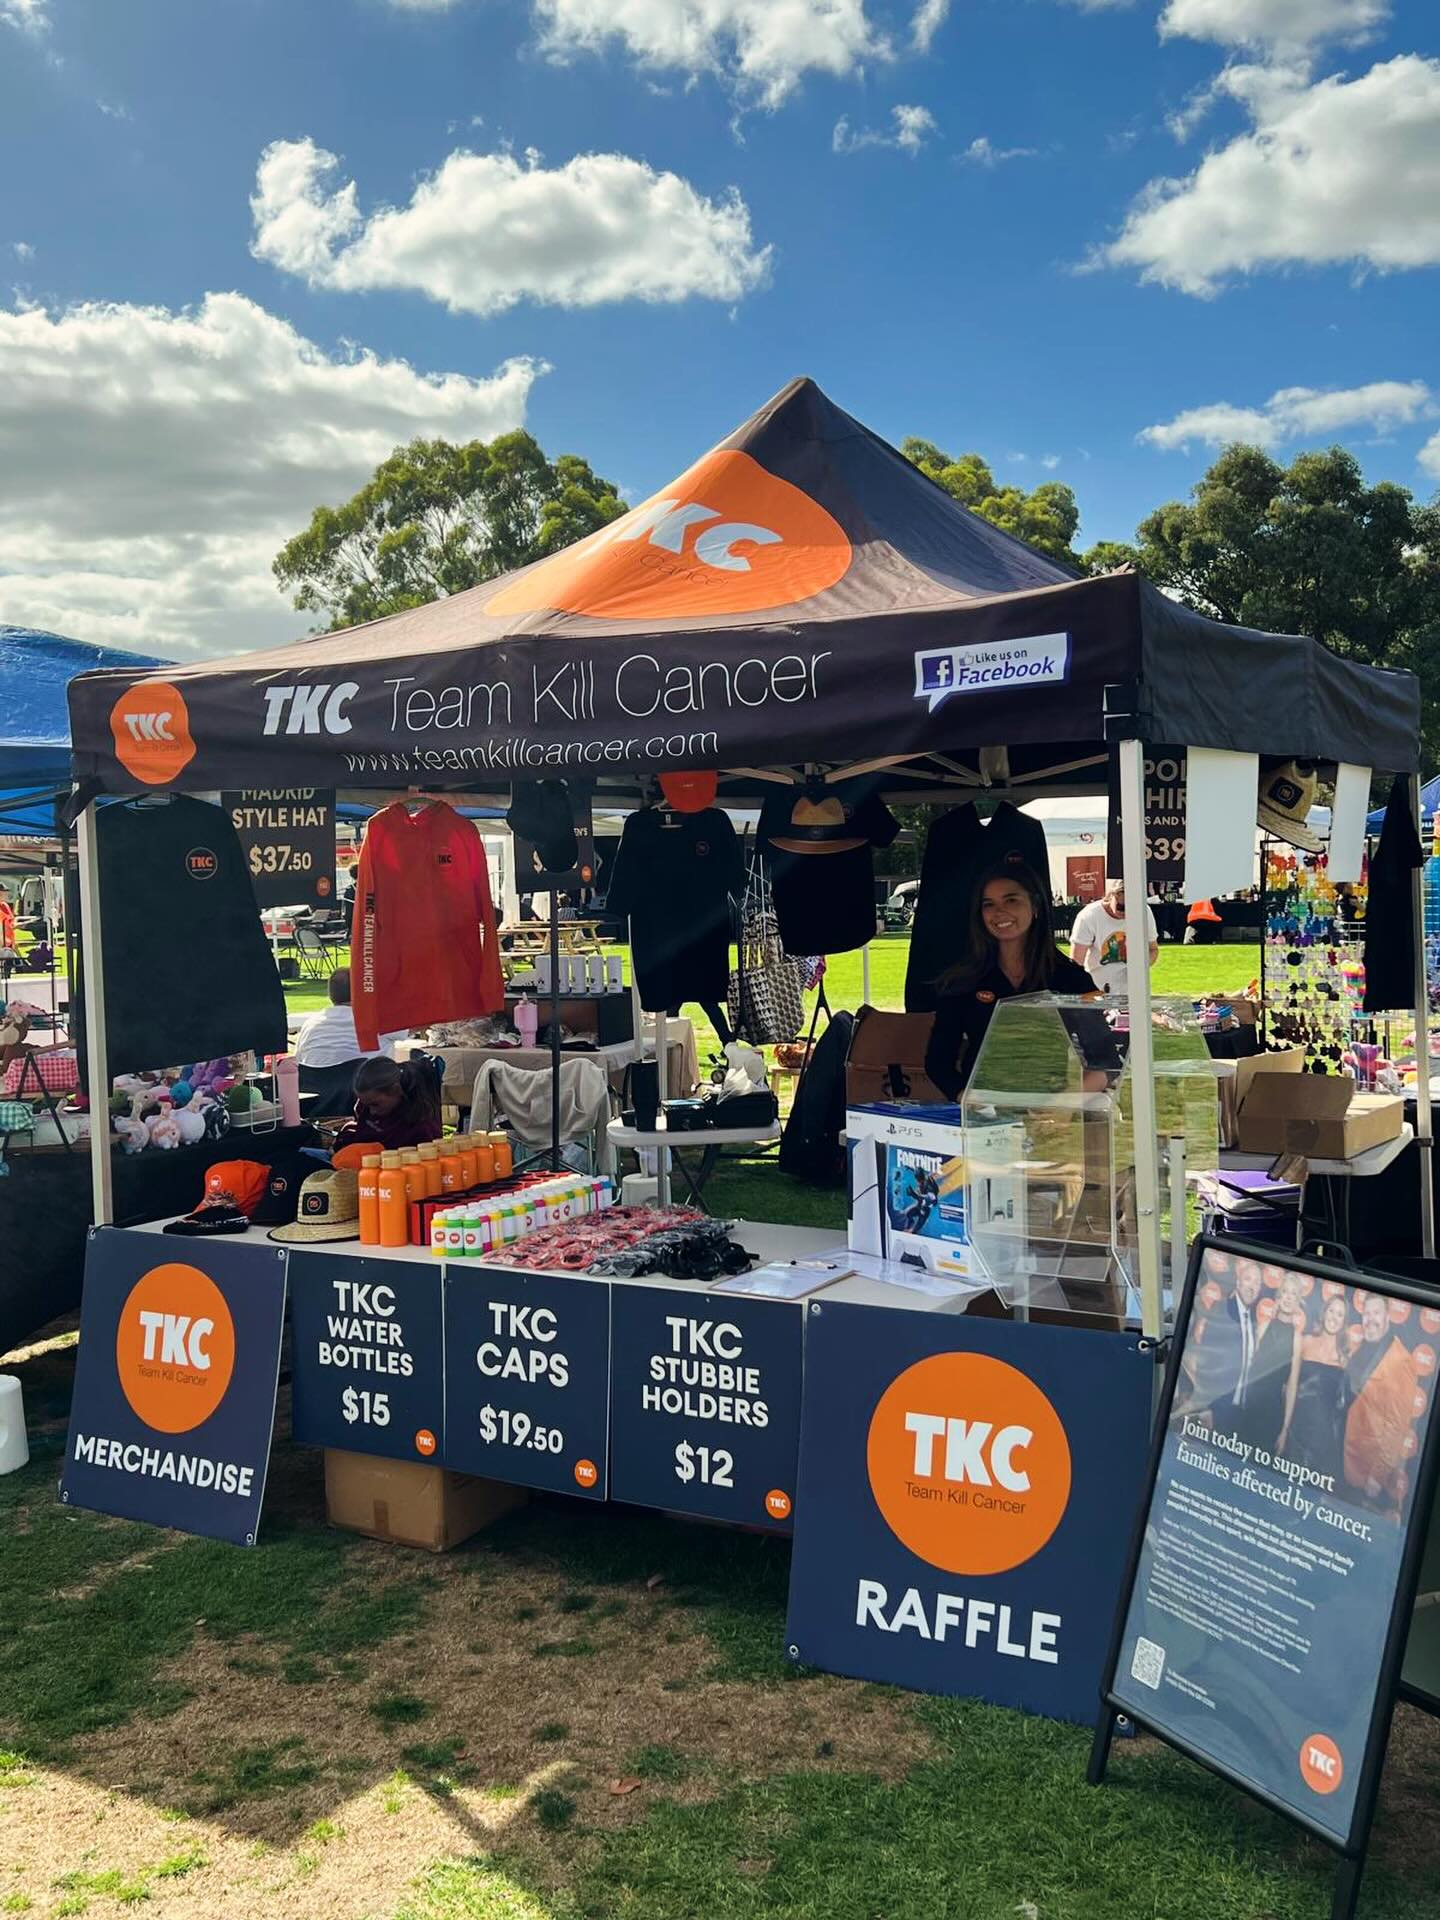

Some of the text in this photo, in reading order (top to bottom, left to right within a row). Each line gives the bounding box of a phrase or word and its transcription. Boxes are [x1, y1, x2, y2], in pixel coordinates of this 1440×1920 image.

[612, 499, 783, 572] KC
[958, 656, 1056, 685] Facebook
[975, 648, 1028, 664] Like us on
[263, 651, 832, 735] TKC Team Kill Cancer
[124, 712, 176, 741] TKC
[344, 730, 719, 772] www.teamkillcancer.com
[1144, 759, 1187, 782] PO
[232, 806, 327, 829] STYLE HAT
[1153, 816, 1179, 825] AND
[190, 856, 213, 868] TKC
[249, 844, 312, 876] $37.50
[898, 1126, 923, 1138] PS5
[333, 1280, 396, 1317] TKC
[139, 1310, 214, 1370] TKC
[327, 1315, 404, 1347] WATER
[488, 1302, 558, 1342] TKC
[665, 1316, 743, 1360] TKC
[319, 1342, 413, 1377] BOTTLES
[476, 1342, 569, 1388] CAPS
[650, 1355, 760, 1394] STUBBIE
[342, 1385, 391, 1426] $15
[642, 1385, 769, 1427] HOLDERS
[479, 1403, 563, 1454] $19.50
[74, 1433, 254, 1497] MERCHANDISE
[675, 1440, 734, 1488] $12
[905, 1411, 1033, 1492] TKC
[1181, 1415, 1336, 1493] Join today to support
[905, 1481, 1026, 1515] Team Kill Cancer
[1176, 1440, 1231, 1481] families
[1231, 1467, 1292, 1507] affected
[1294, 1490, 1314, 1520] by
[1316, 1504, 1373, 1542] cancer.
[855, 1578, 1062, 1664] RAFFLE
[1308, 1747, 1337, 1777] TKC
